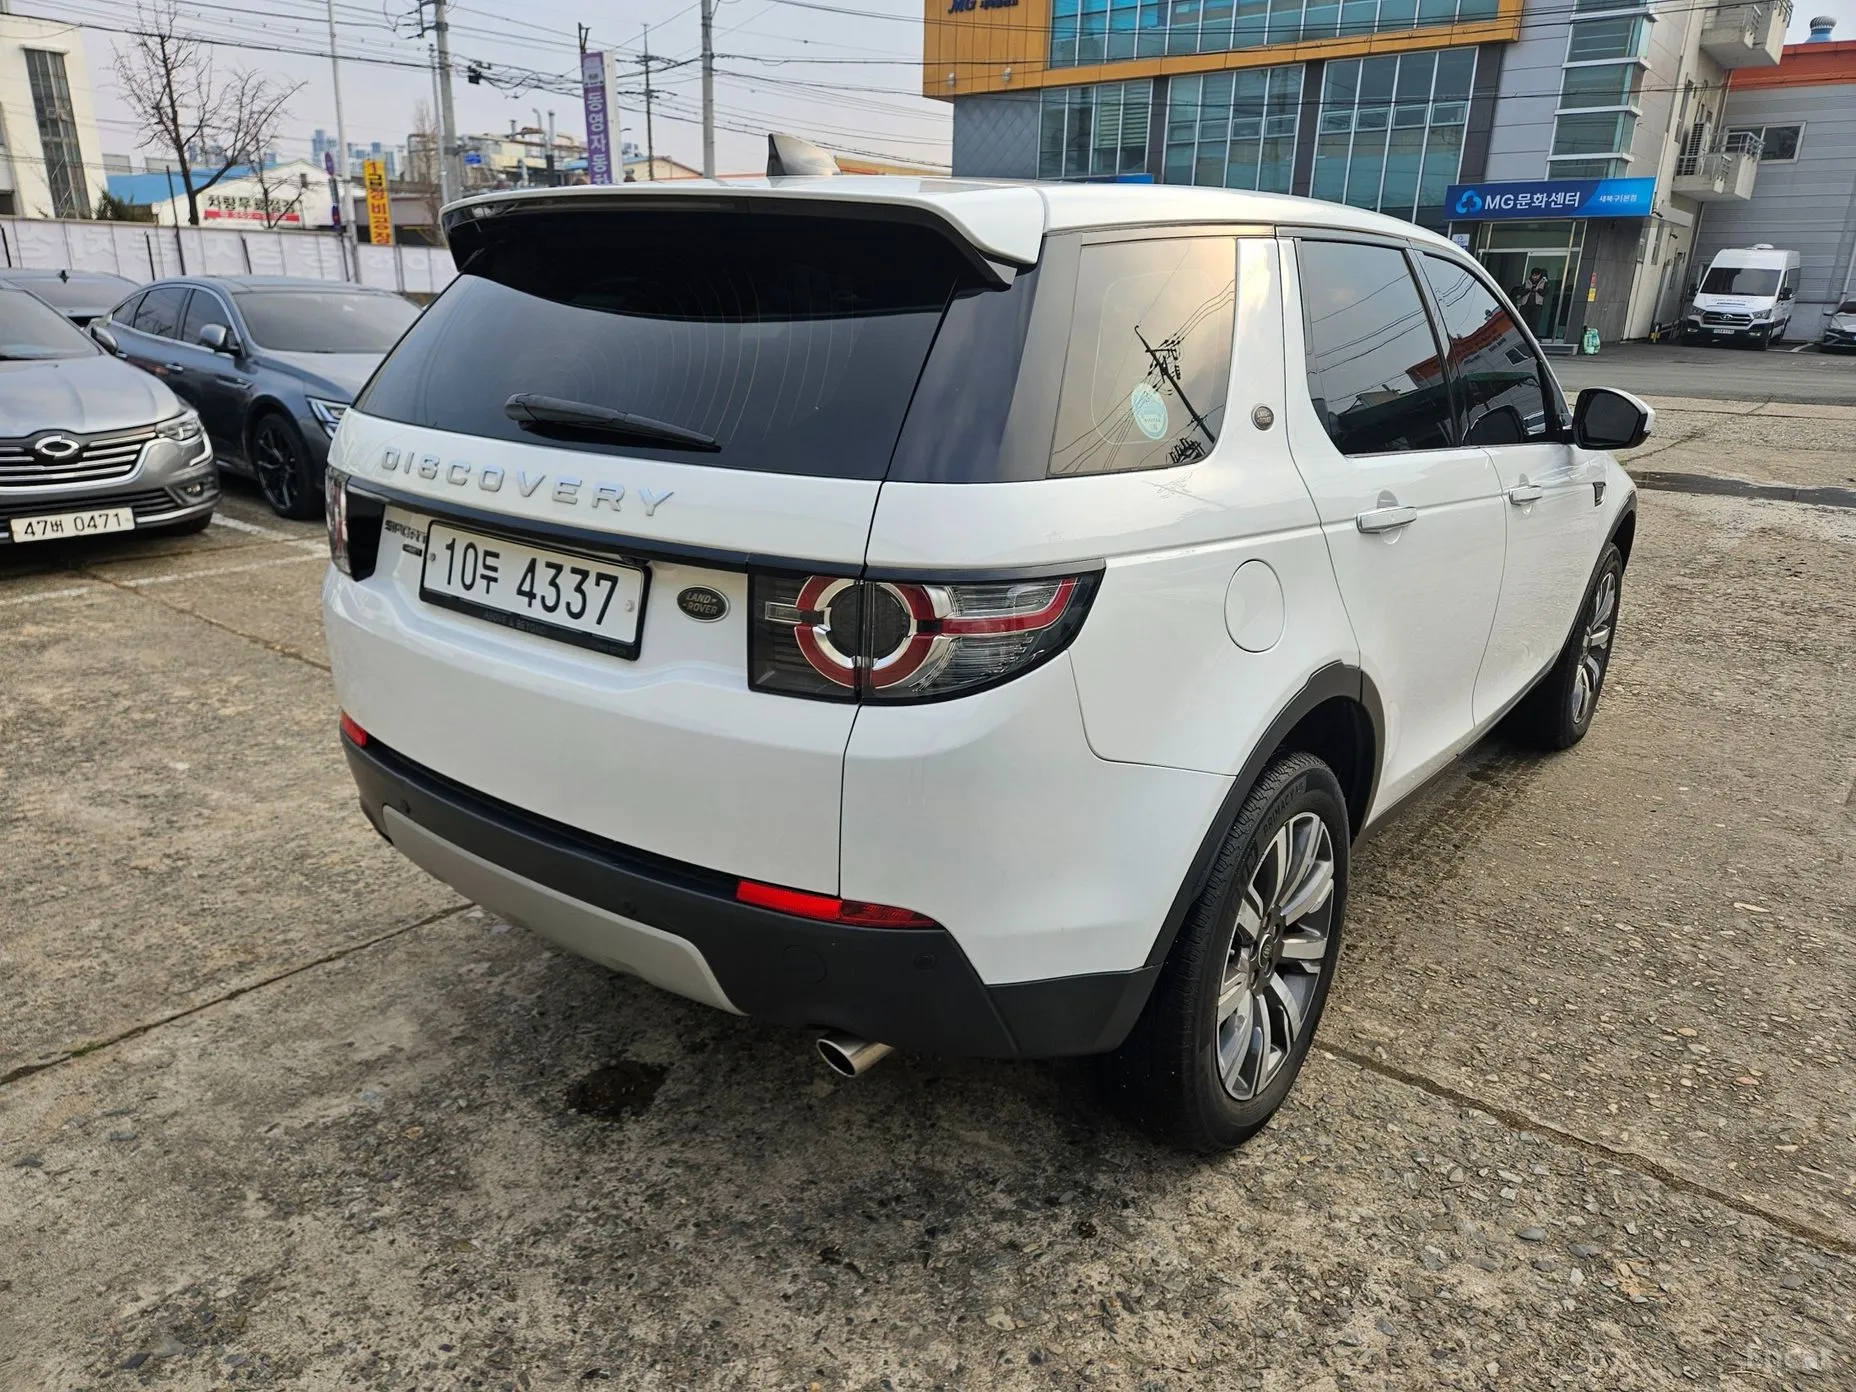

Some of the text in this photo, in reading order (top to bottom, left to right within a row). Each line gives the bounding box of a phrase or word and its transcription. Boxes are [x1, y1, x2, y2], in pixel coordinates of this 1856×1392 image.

[1484, 191, 1581, 210] MG문화센터
[381, 446, 674, 516] DISCOVERY
[24, 512, 122, 537] 47버 0471
[445, 537, 619, 626] 10두 4337
[686, 591, 712, 604] LAND
[687, 601, 718, 616] ROVER
